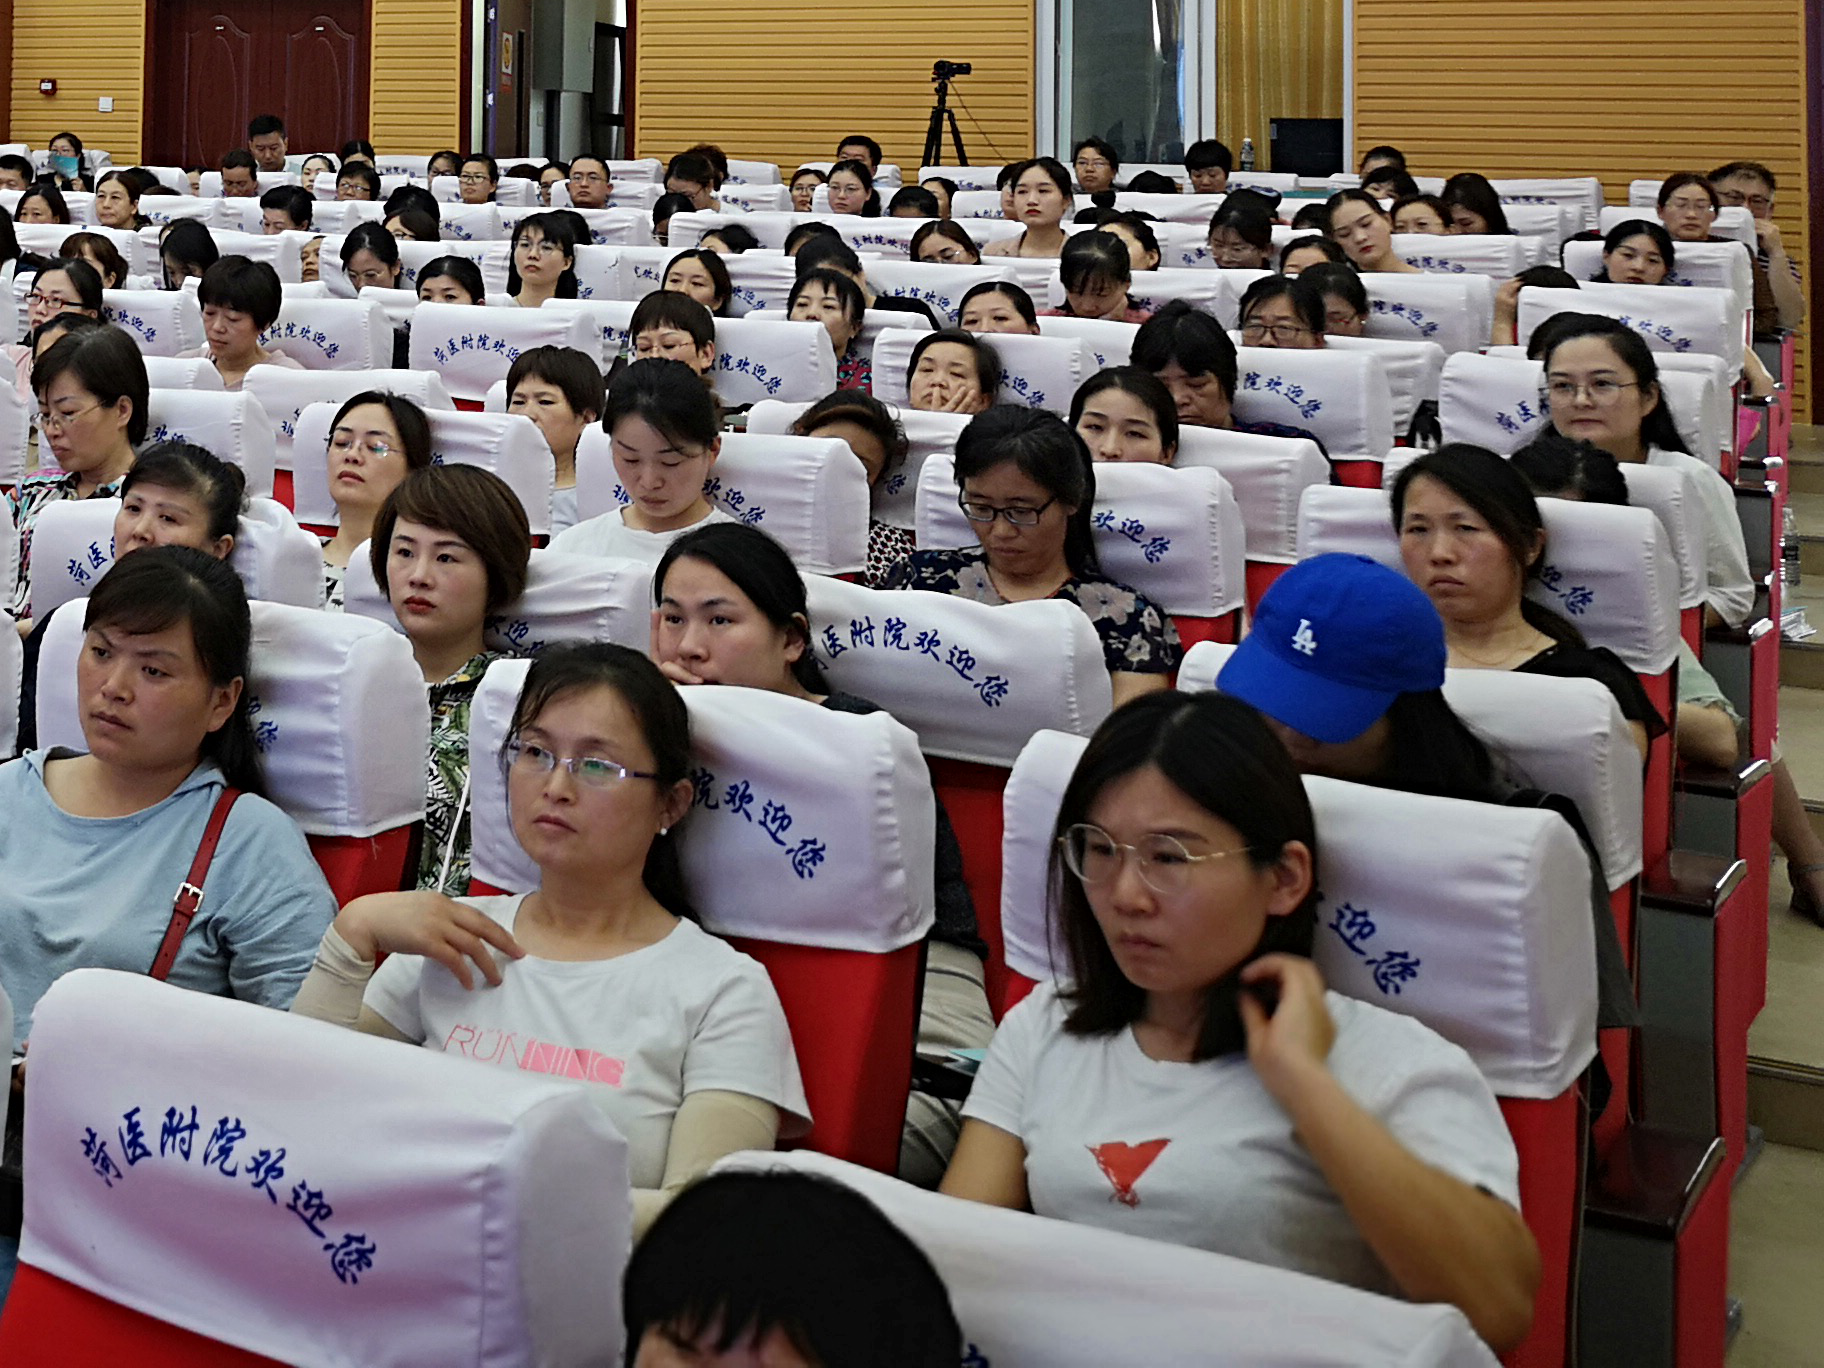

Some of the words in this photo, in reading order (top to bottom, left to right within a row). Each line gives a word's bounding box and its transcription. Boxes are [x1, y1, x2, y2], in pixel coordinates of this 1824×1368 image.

[433, 333, 520, 365] 菏医附院欢迎
[715, 353, 783, 392] 院欢迎您
[1243, 372, 1322, 419] 院欢迎您
[816, 613, 1010, 708] 医附院欢迎您
[1291, 618, 1318, 656] LA
[443, 1024, 624, 1088] RUNNING
[79, 1105, 377, 1285] 菏医附院欢迎您
